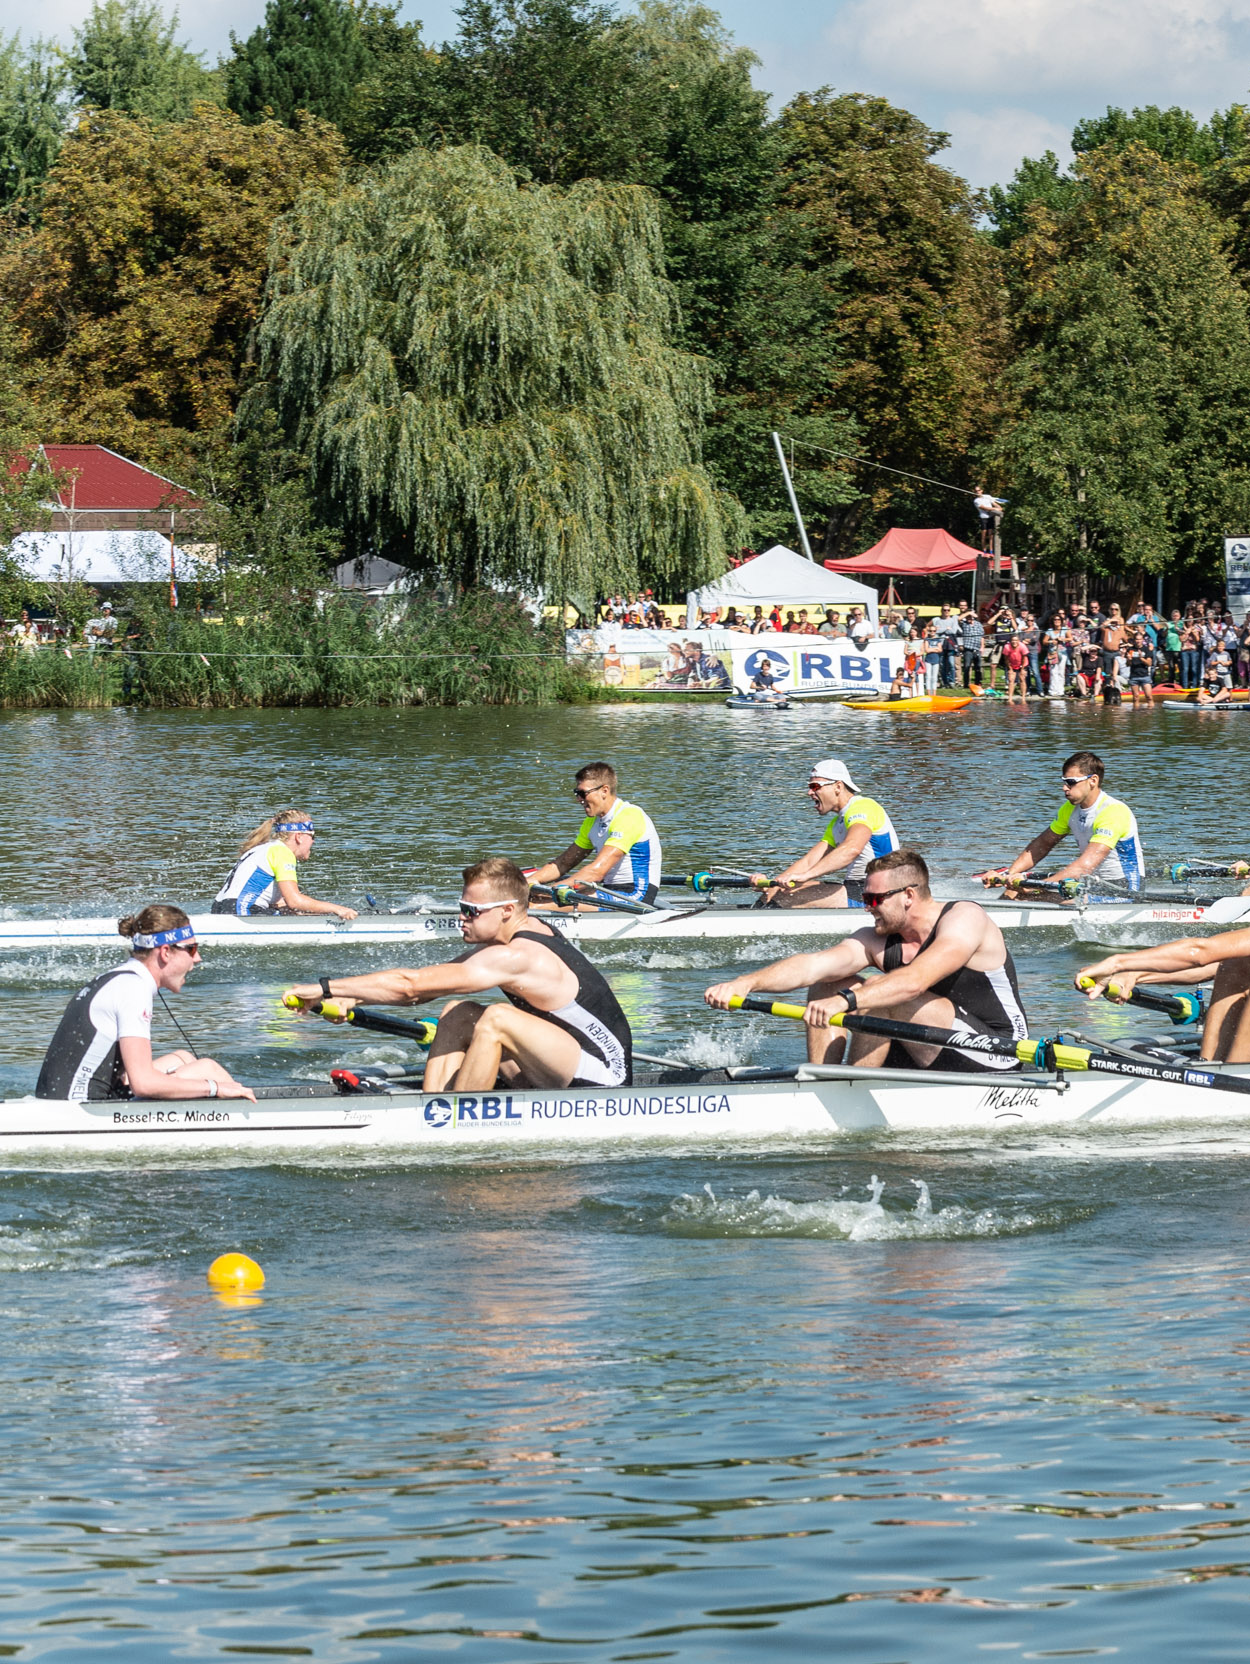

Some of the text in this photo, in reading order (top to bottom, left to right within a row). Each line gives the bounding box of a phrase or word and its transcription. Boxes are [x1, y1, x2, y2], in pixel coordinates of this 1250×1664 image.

[800, 652, 910, 684] RBL
[1152, 909, 1192, 921] hilzinger
[164, 931, 177, 943] NK
[181, 927, 192, 938] NK
[946, 1031, 994, 1052] Melitta
[1091, 1058, 1211, 1086] STARK. SCHNELL. GUT. RBL
[458, 1096, 522, 1121] RBL
[531, 1094, 731, 1119] RUDER-BUNDESLIGA
[976, 1086, 1040, 1110] Melitta
[113, 1111, 230, 1124] Bessel-R.C. Minden
